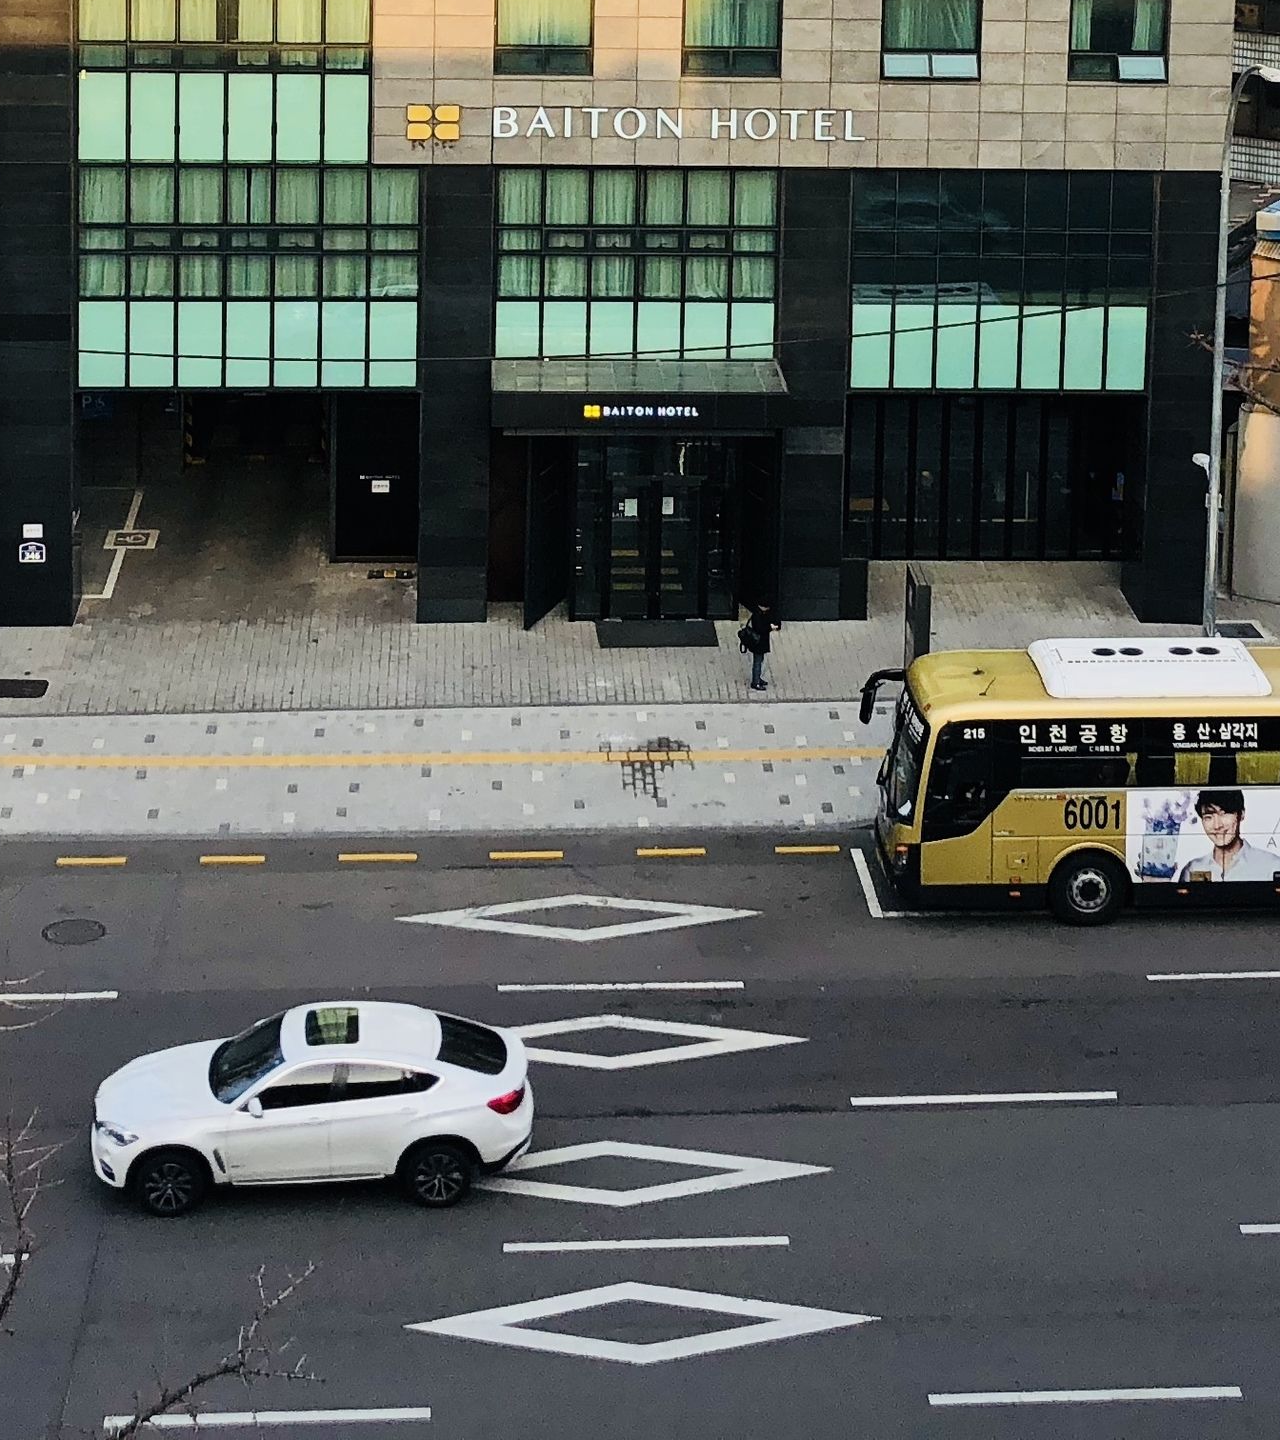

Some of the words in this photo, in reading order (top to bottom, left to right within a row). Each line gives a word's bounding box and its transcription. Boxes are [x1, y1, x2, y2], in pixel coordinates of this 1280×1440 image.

[493, 106, 683, 140] BAITON
[711, 108, 866, 142] HOTEL
[603, 406, 654, 417] BAITON
[657, 406, 700, 417] HOTEL
[963, 728, 986, 739] 215
[1018, 723, 1129, 744] 인천공항
[1064, 799, 1121, 831] 6001
[1266, 836, 1278, 848] A
